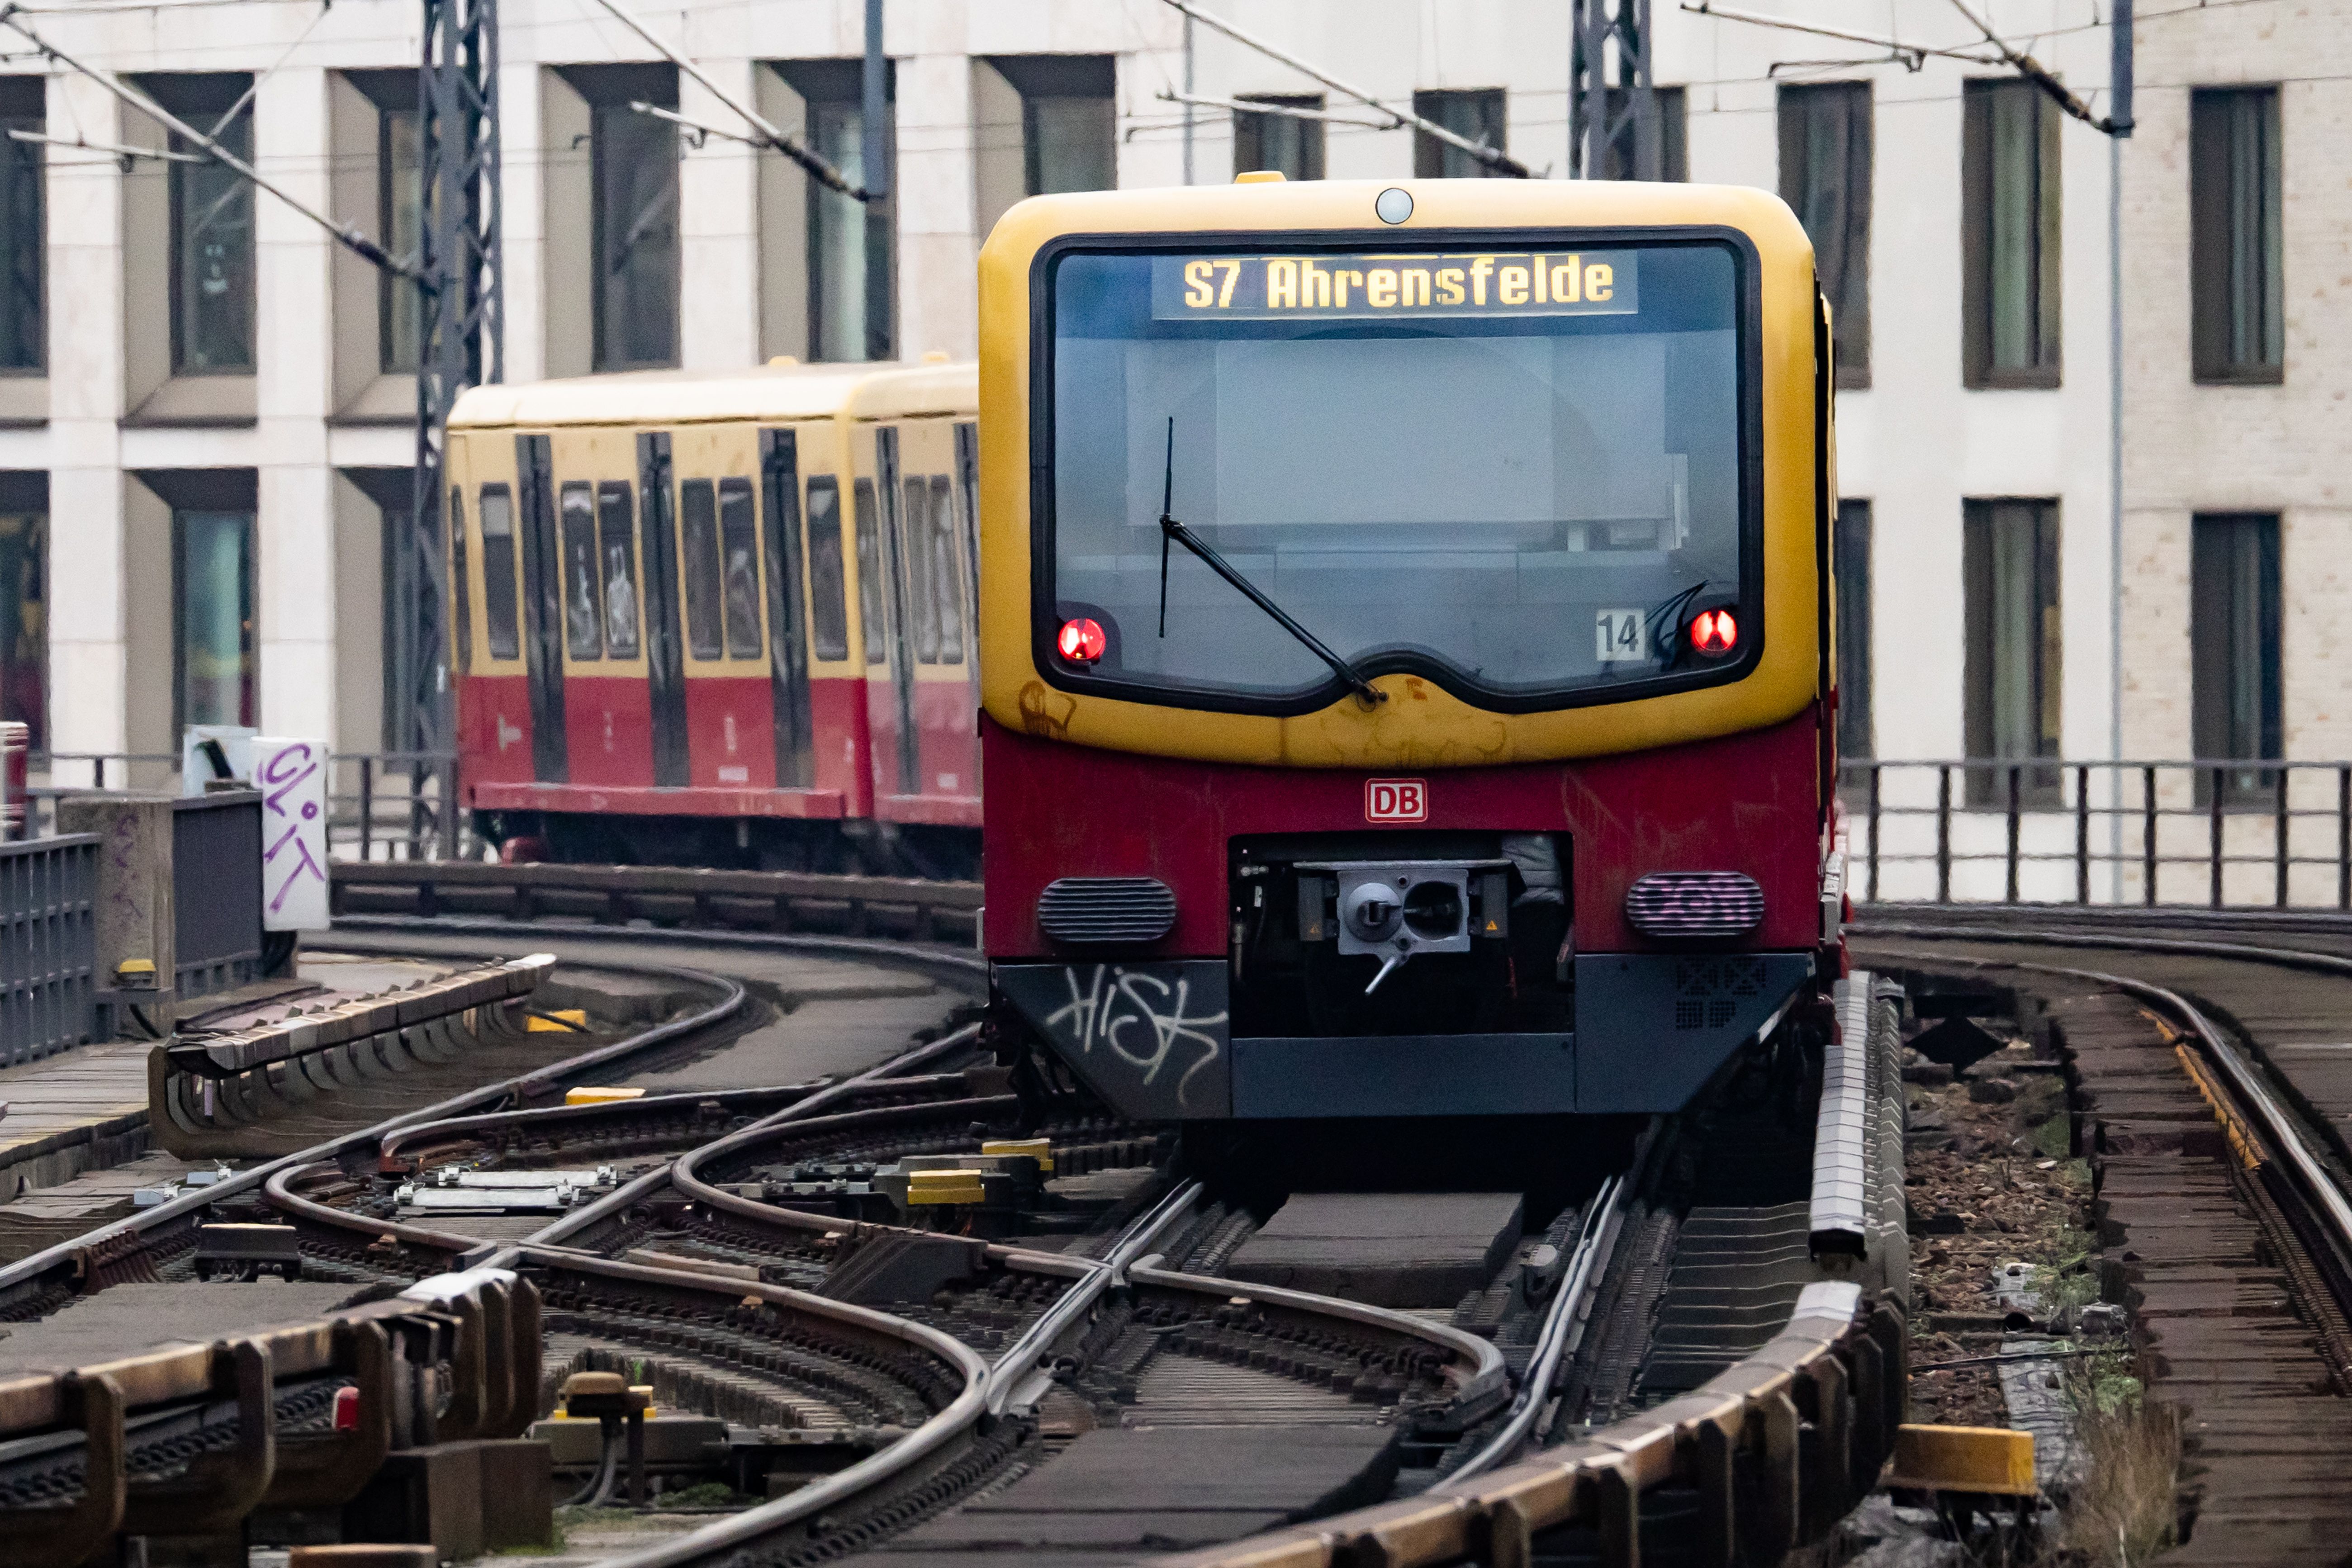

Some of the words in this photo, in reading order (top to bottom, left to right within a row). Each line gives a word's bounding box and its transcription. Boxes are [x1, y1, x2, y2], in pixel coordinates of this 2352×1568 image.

[1184, 261, 1241, 308] S7
[1267, 255, 1613, 308] Ahrensfelde
[1598, 615, 1639, 652] 14
[1375, 786, 1420, 815] DB
